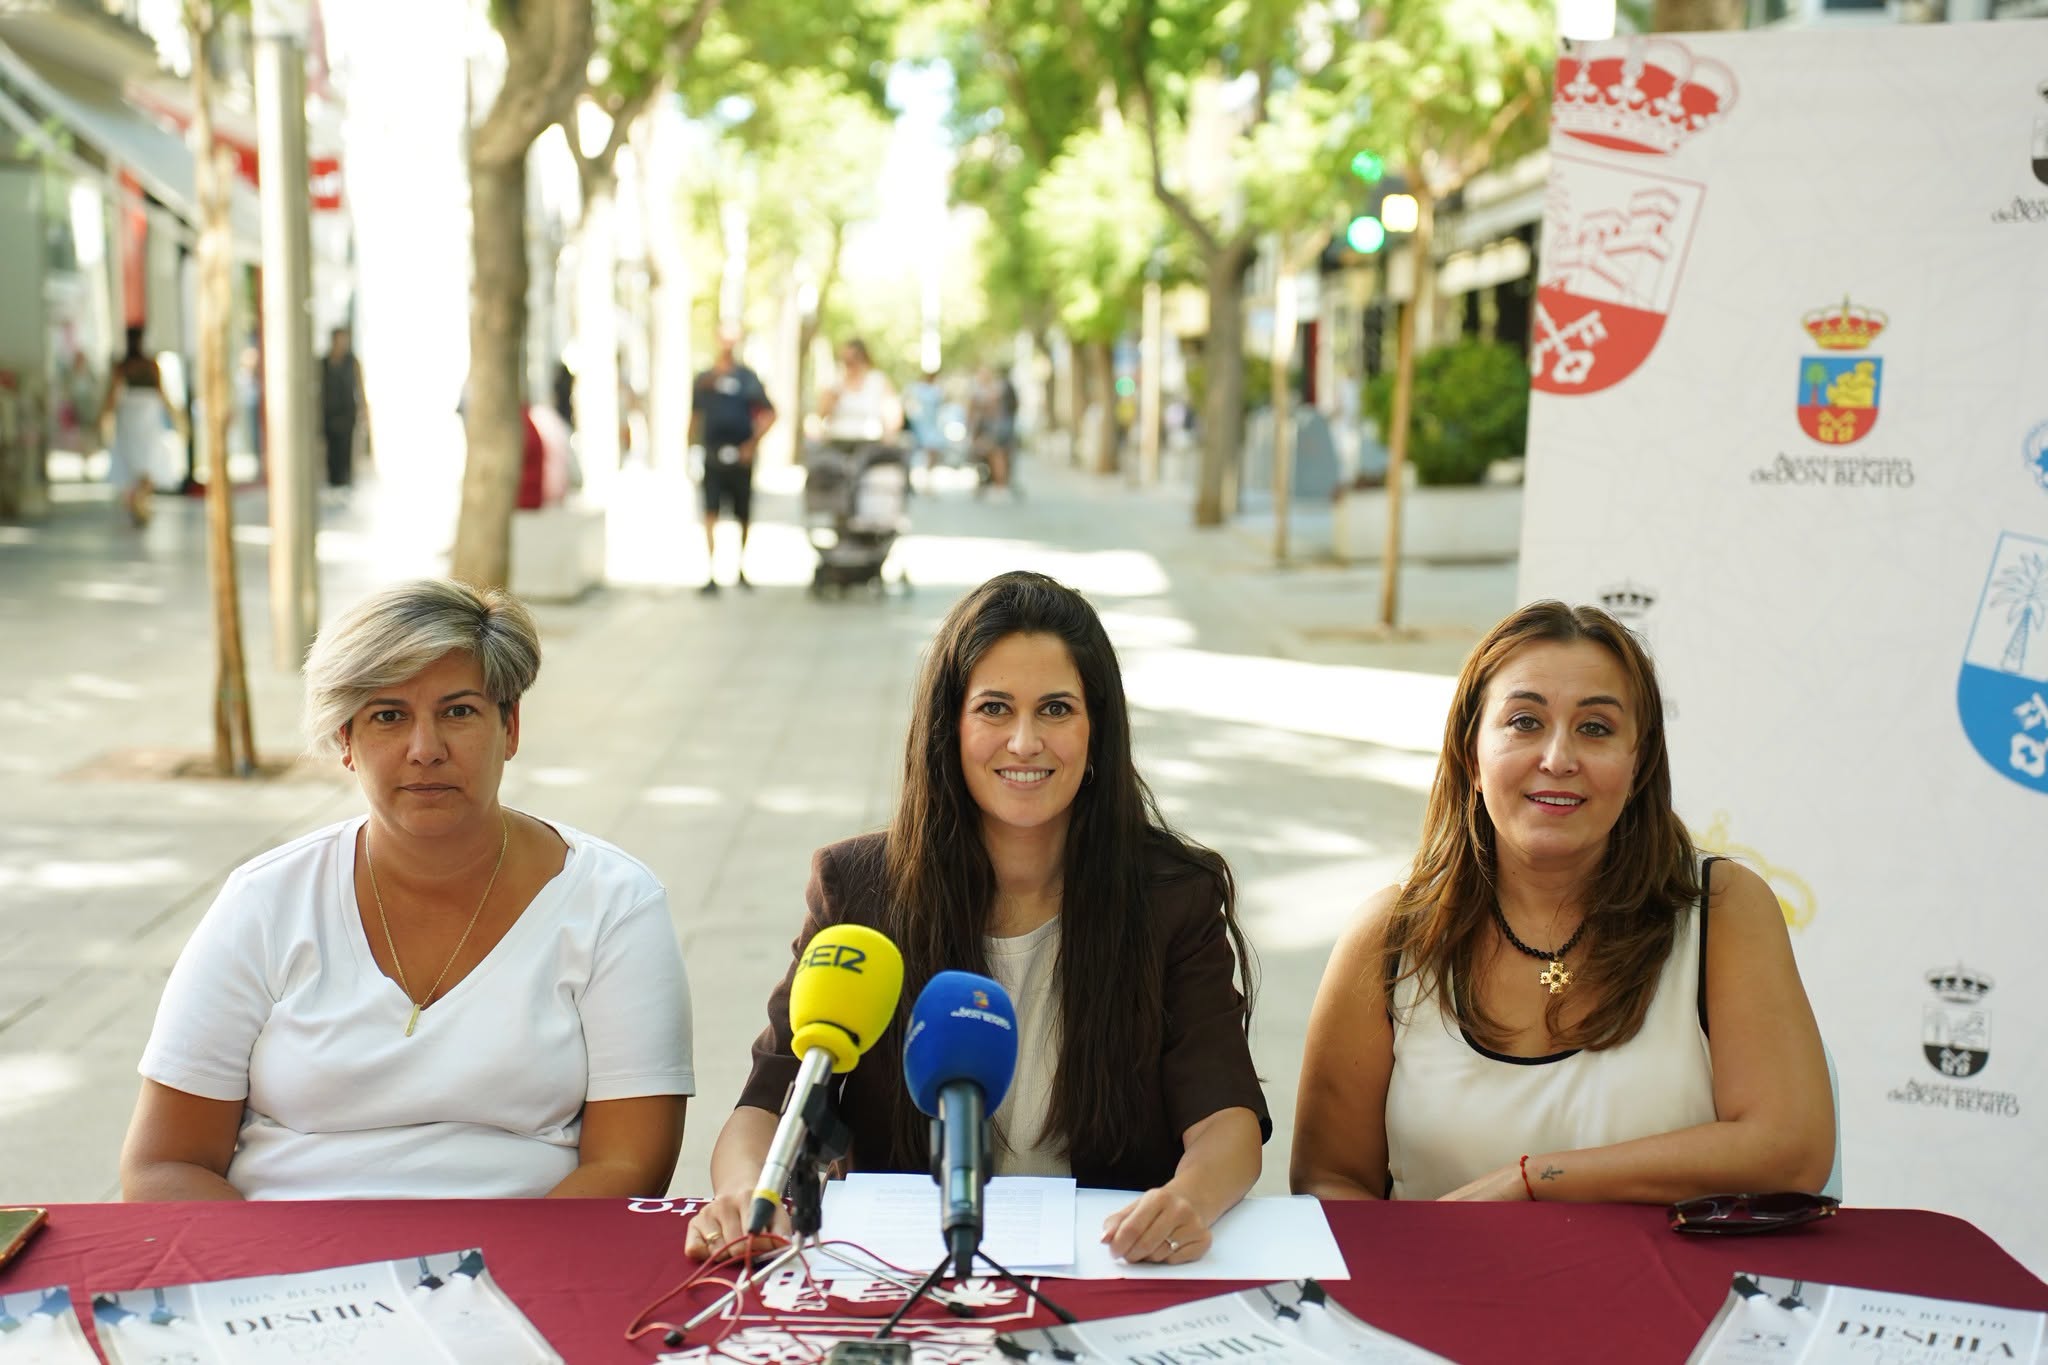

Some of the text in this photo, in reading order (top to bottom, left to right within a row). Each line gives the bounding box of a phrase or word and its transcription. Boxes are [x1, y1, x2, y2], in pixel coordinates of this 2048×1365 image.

[1834, 463, 1915, 488] BENITO
[1955, 1094, 2020, 1118] BENITO
[287, 1282, 367, 1299] BENITO
[1159, 1313, 1231, 1335] BENITO
[1919, 1311, 2007, 1330] BENITO
